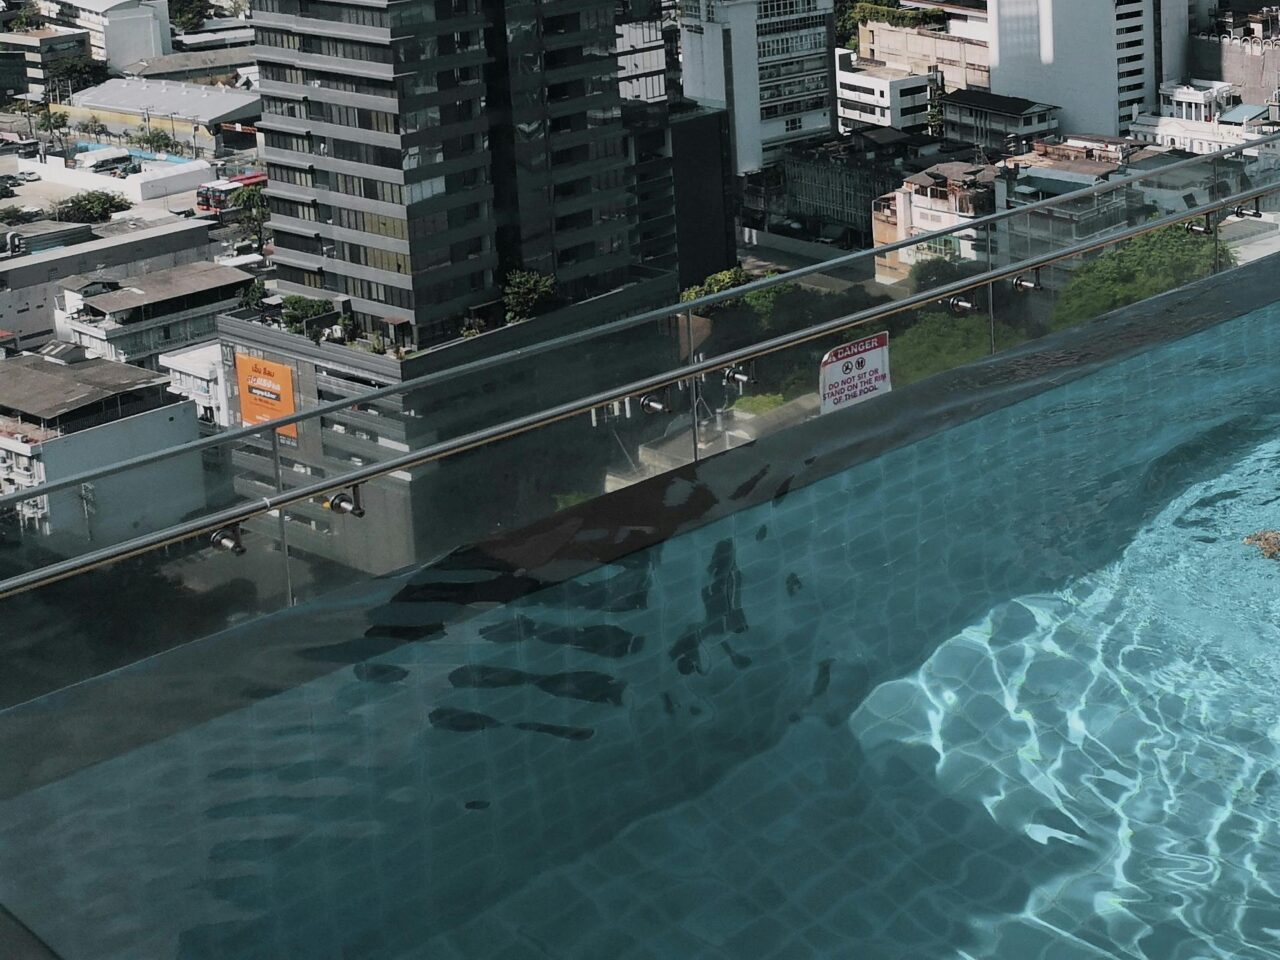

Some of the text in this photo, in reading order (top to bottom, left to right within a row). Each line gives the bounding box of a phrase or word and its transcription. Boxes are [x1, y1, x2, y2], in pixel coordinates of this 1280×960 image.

[838, 339, 878, 358] DANGER
[823, 373, 887, 401] STAND ON THE RIM
[828, 368, 879, 390] DO NOT SIT OR
[833, 385, 879, 405] OF THE POOL
